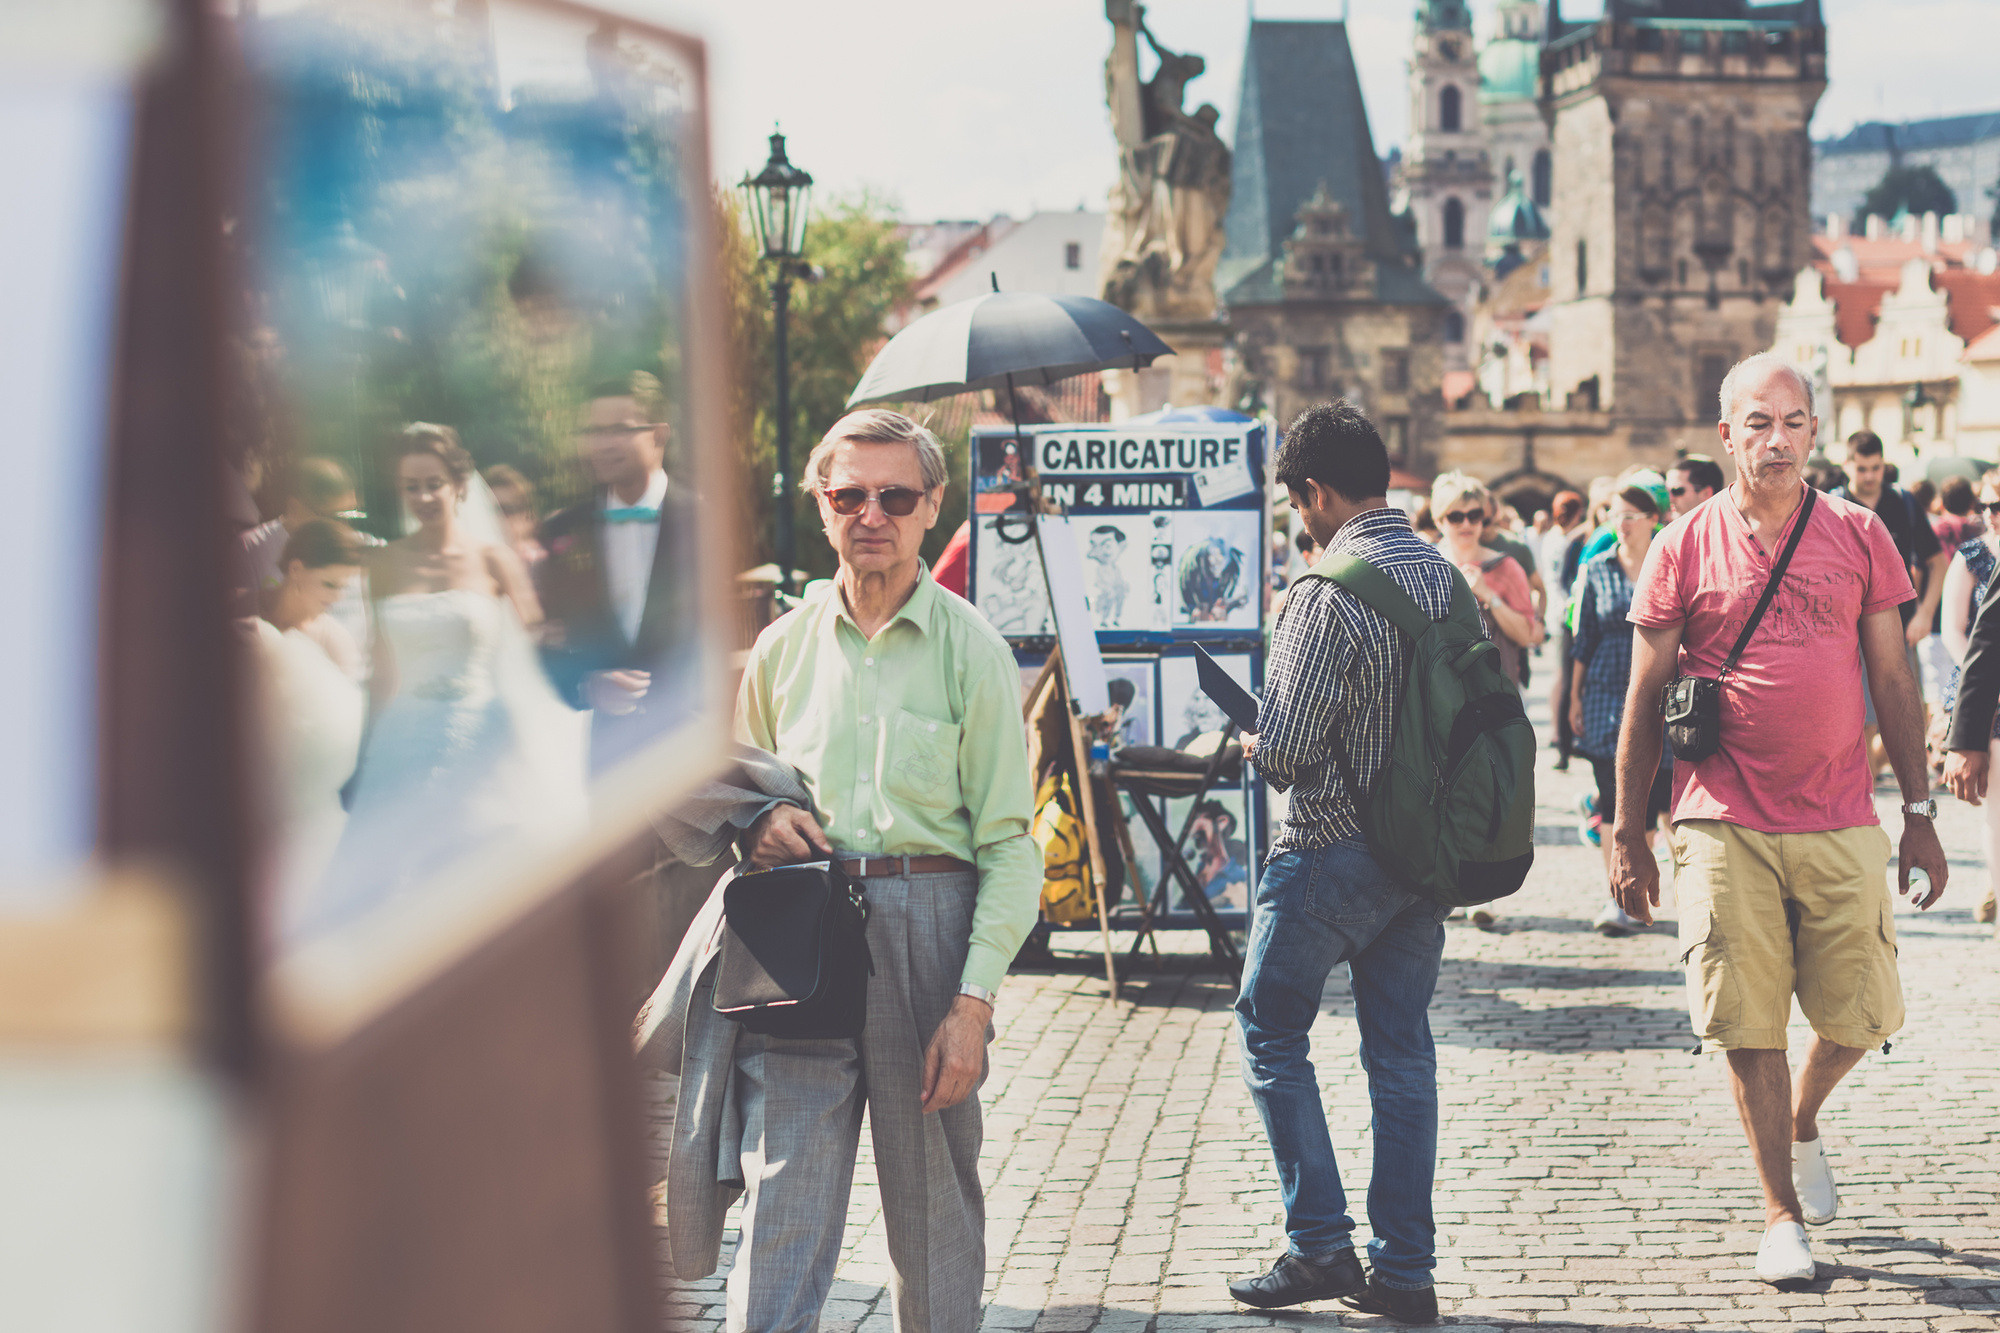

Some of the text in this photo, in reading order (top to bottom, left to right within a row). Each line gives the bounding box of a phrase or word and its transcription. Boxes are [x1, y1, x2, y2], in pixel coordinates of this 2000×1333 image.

[1043, 438, 1240, 470] CARICATURE
[1042, 483, 1183, 506] IN 4 MIN.
